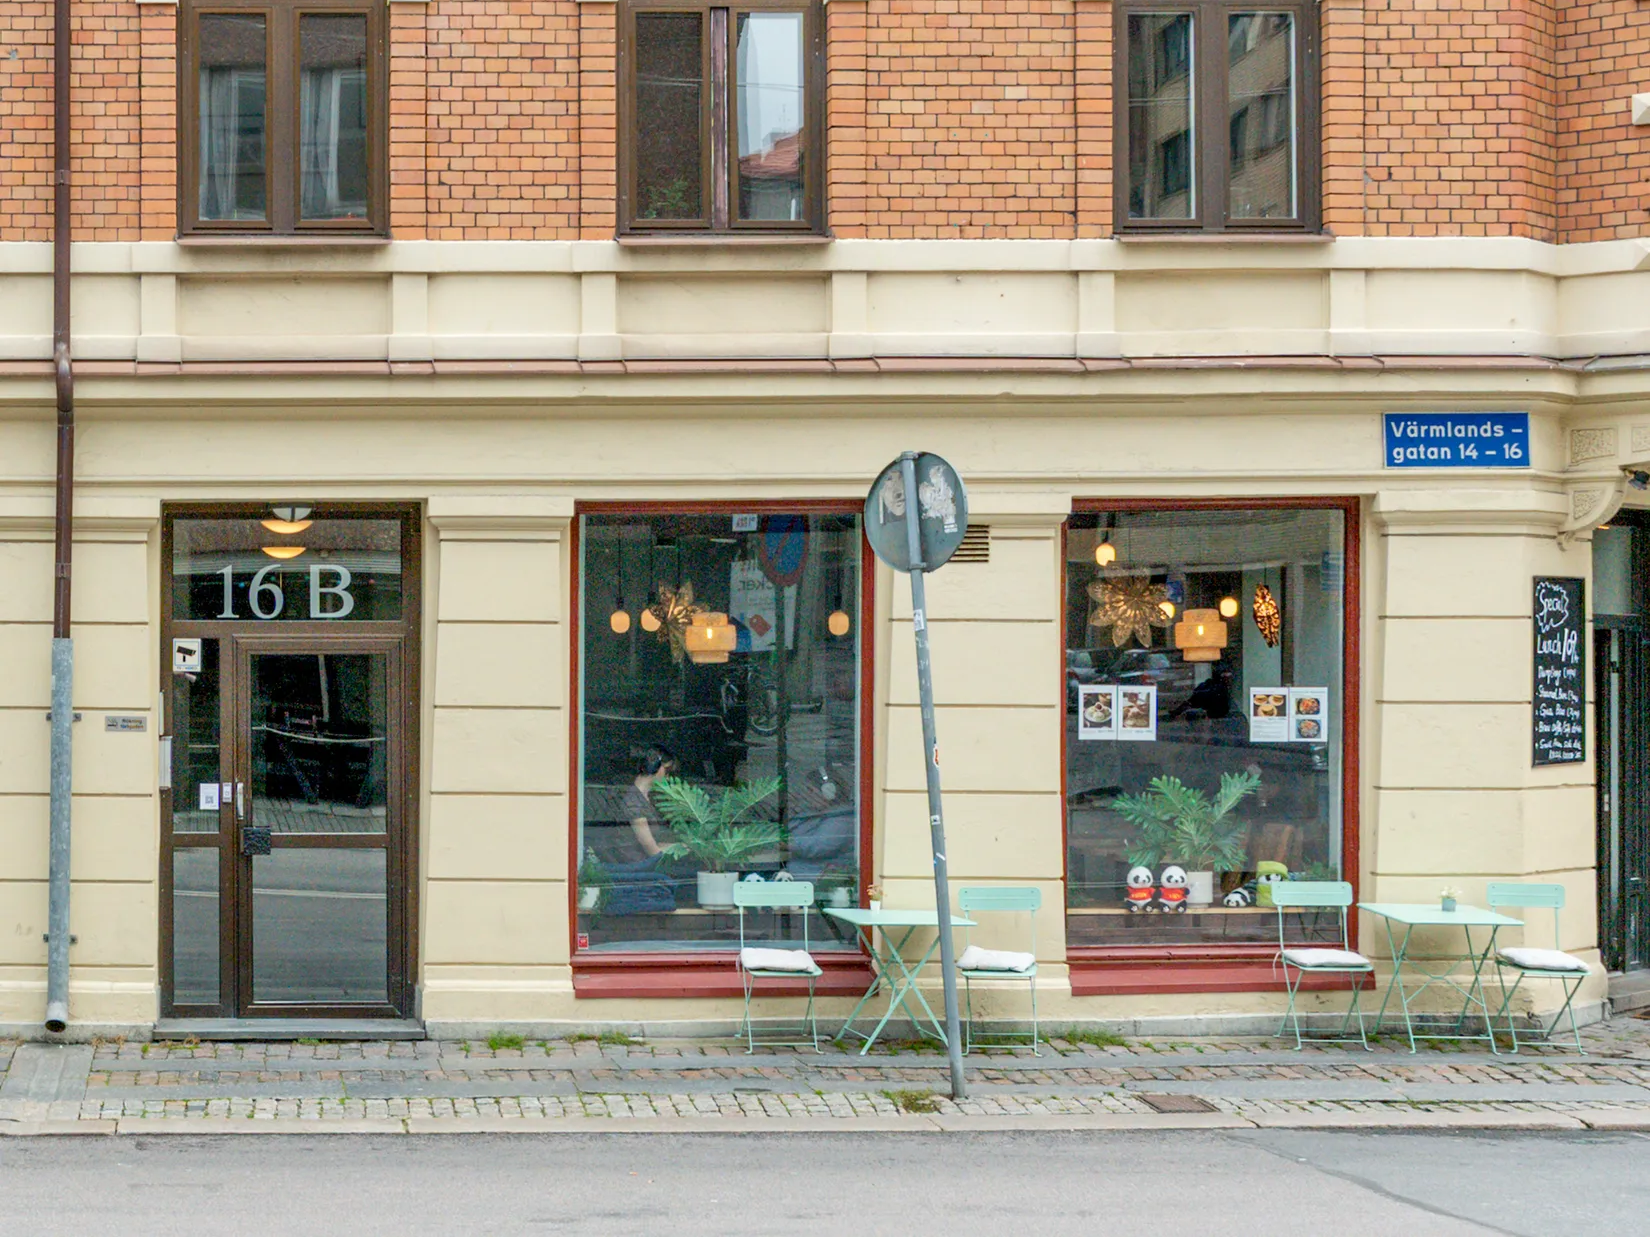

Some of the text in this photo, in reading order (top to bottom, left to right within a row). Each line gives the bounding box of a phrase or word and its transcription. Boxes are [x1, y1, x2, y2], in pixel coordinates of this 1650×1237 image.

[1390, 421, 1505, 438] Värmlands
[1392, 443, 1451, 464] gatan
[1458, 443, 1479, 460] 14
[1502, 442, 1523, 460] 16
[216, 564, 354, 619] 16 B
[1537, 632, 1562, 655] Lunch
